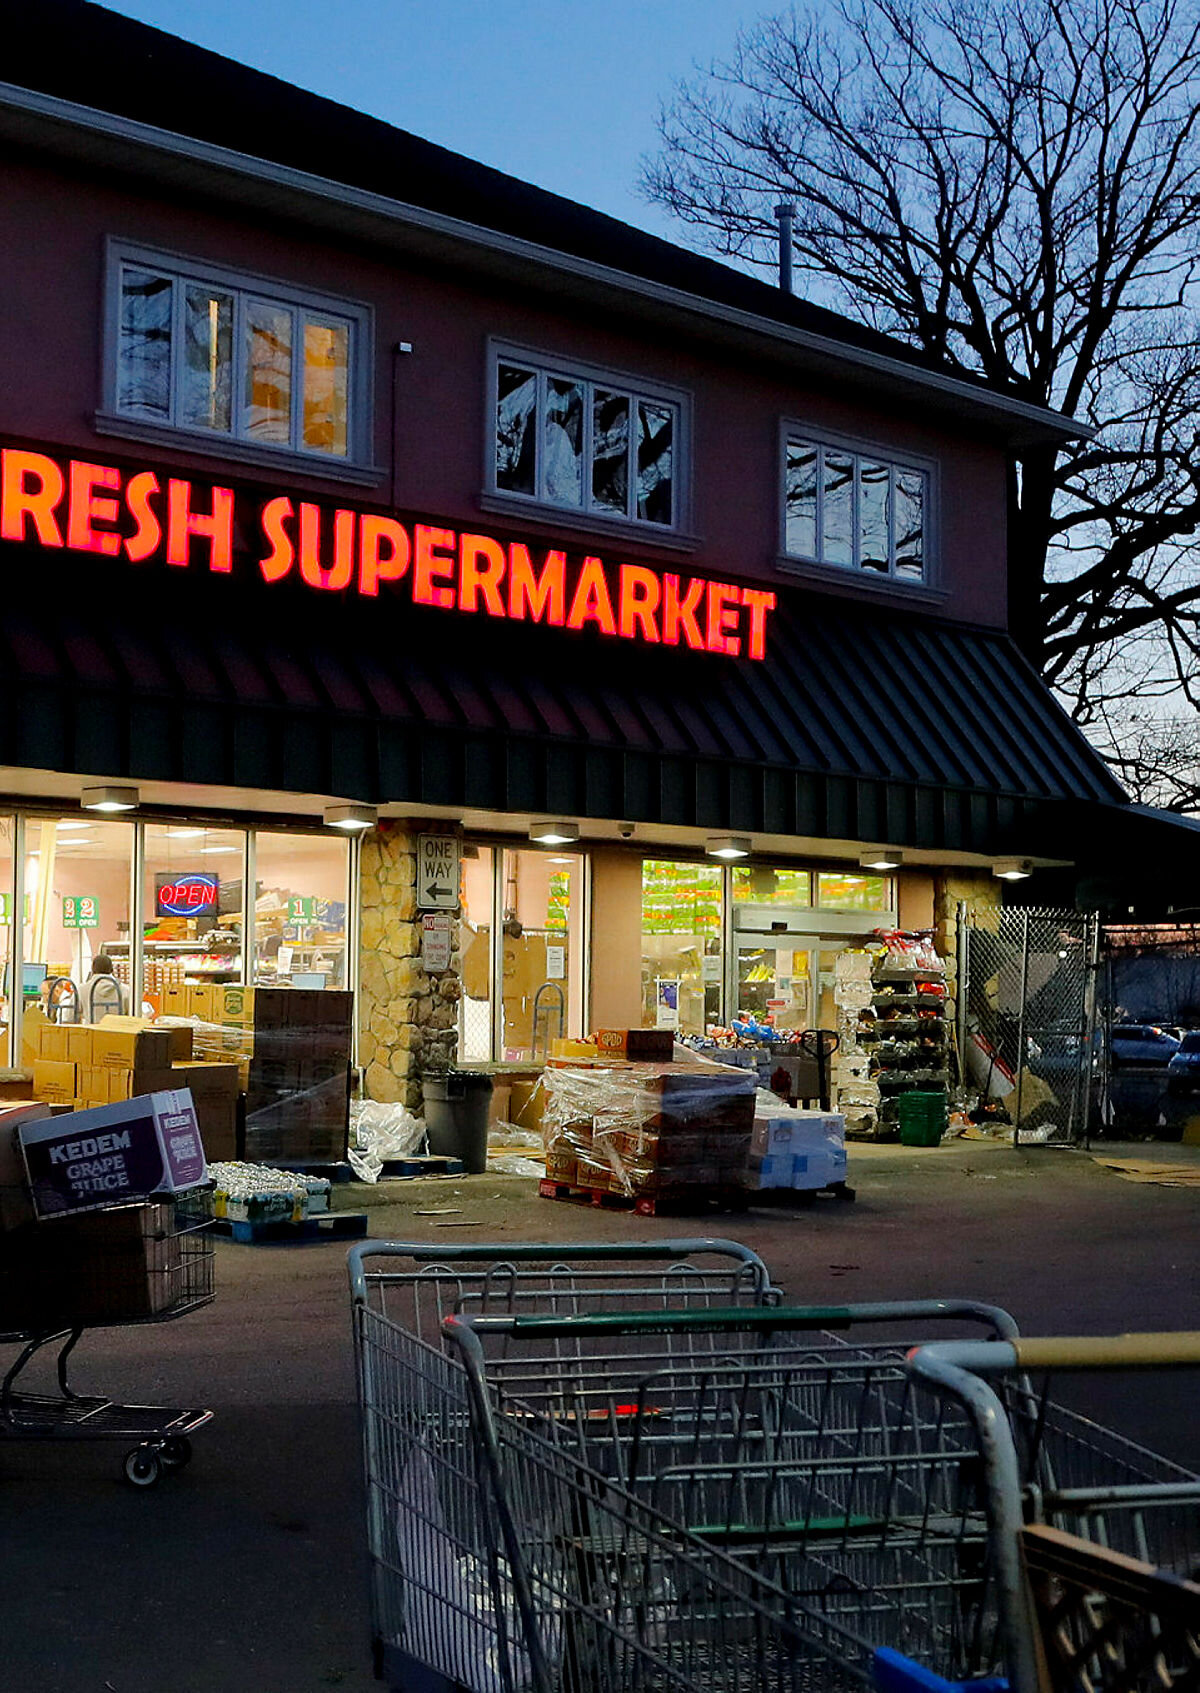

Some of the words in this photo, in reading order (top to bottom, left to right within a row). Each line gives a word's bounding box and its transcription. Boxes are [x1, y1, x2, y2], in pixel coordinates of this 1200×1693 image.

[259, 496, 776, 661] SUPERMARKET
[425, 840, 452, 859] ONE
[425, 861, 453, 879] WAY
[158, 884, 217, 906] OPEN
[81, 897, 95, 918] 2
[293, 899, 305, 916] 1
[49, 1130, 132, 1165] KEDEM
[66, 1153, 125, 1179] GRAPE
[71, 1171, 129, 1198] JUICE
